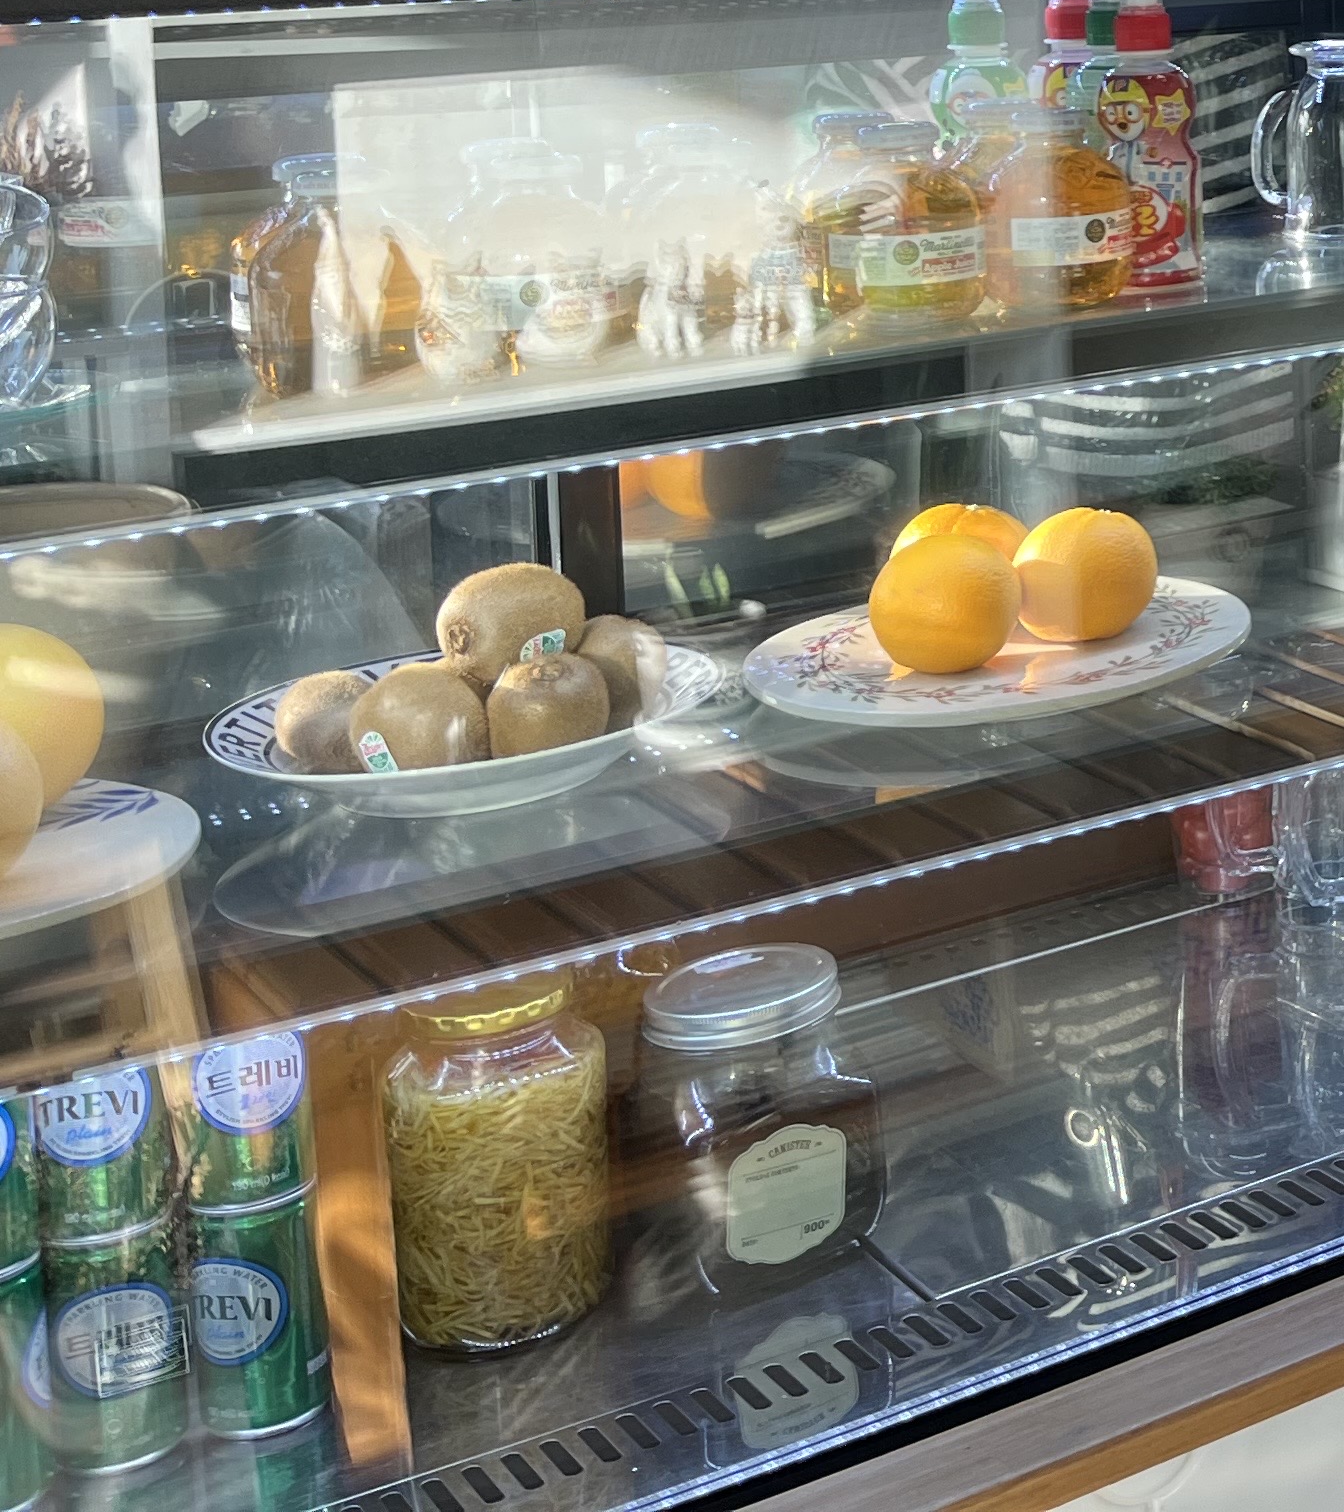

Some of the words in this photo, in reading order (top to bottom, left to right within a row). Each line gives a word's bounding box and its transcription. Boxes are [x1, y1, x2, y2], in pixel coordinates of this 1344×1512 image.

[206, 1054, 299, 1099] 트레비
[40, 1089, 139, 1128] TREVI
[768, 1140, 812, 1159] CANISTER
[194, 1295, 273, 1321] REVI
